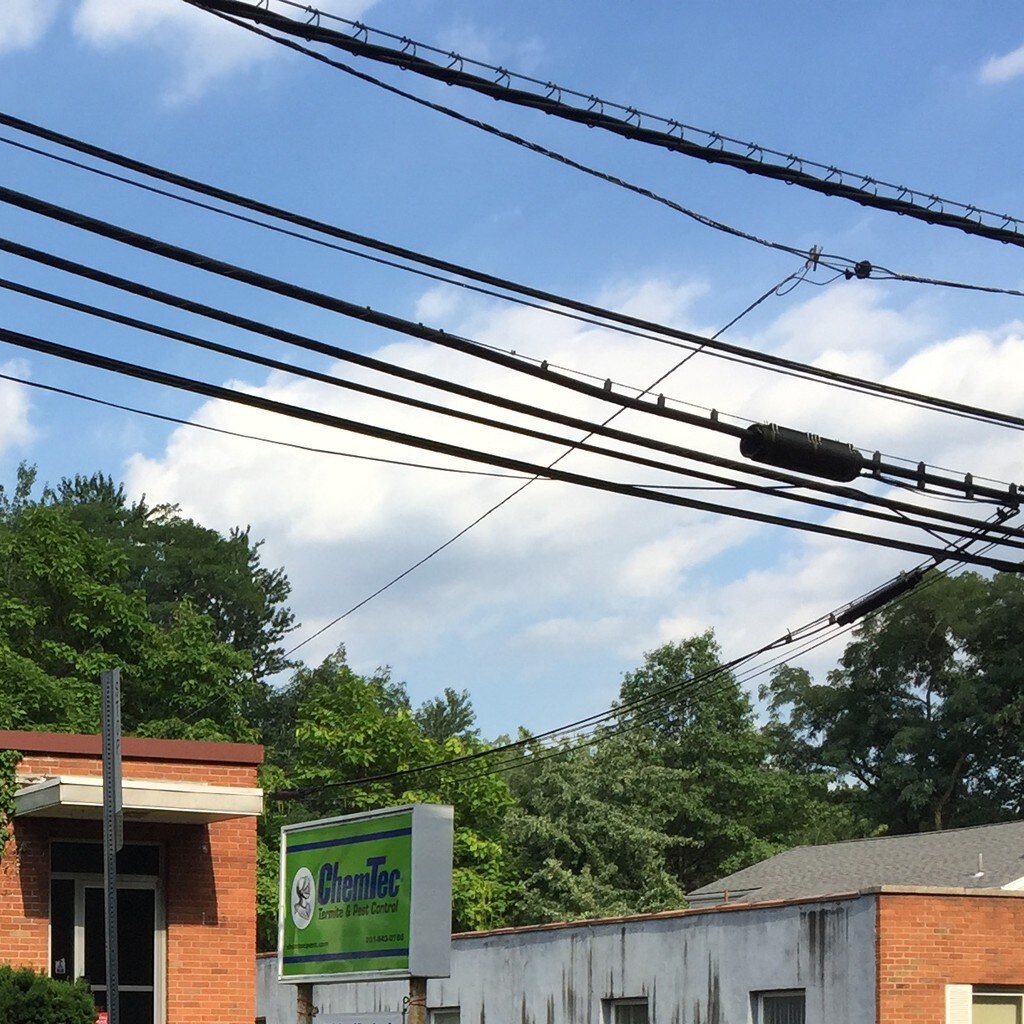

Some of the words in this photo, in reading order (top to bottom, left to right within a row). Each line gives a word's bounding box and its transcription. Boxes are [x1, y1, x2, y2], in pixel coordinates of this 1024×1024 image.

[319, 857, 401, 904] ChemTec
[346, 905, 351, 917] &
[353, 903, 369, 916] Pest
[371, 899, 399, 915] Control
